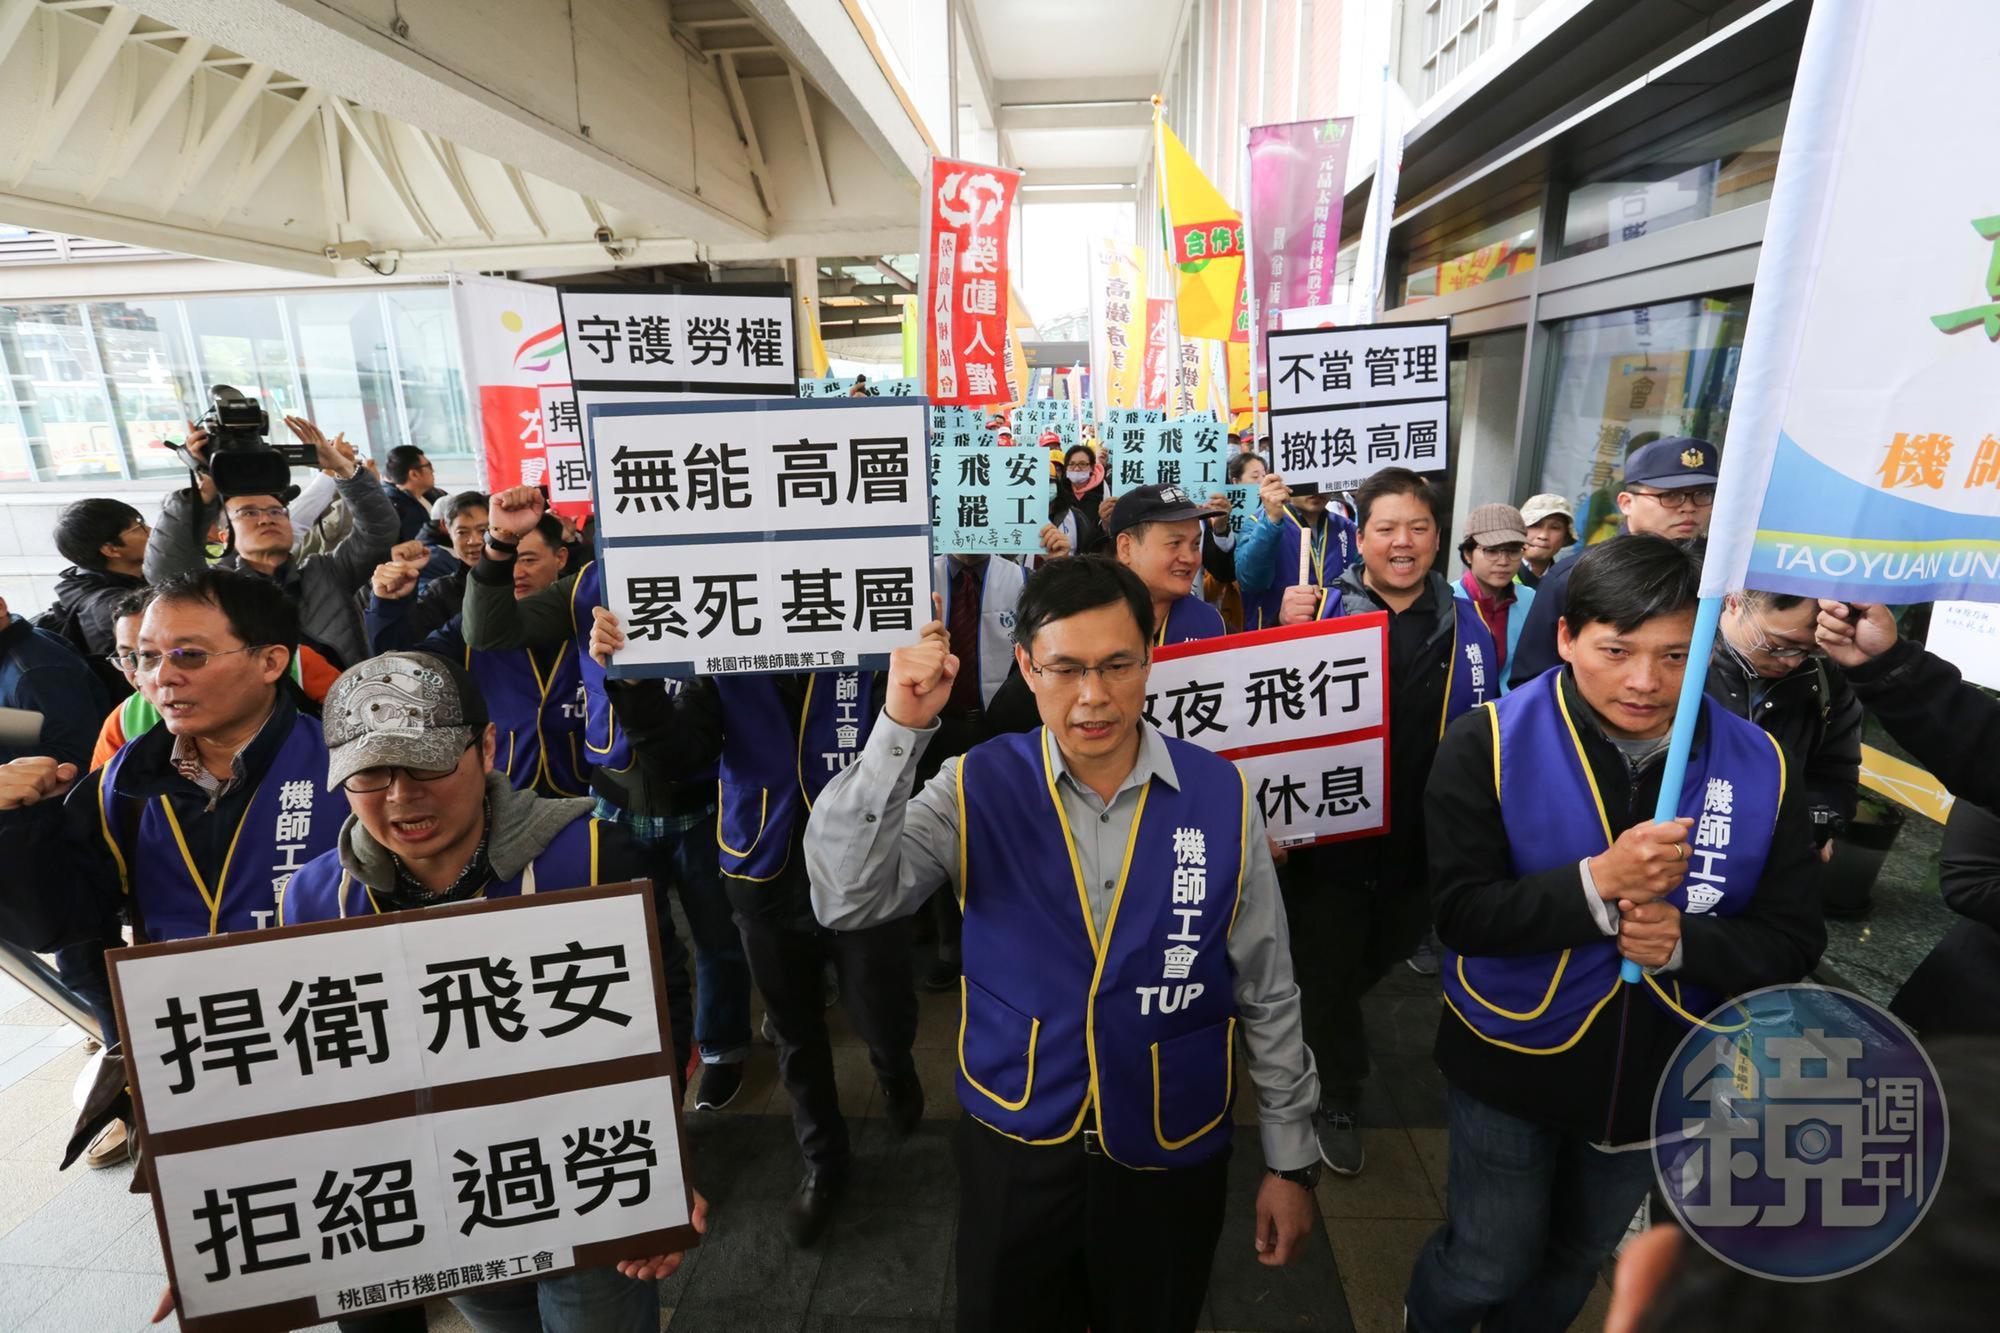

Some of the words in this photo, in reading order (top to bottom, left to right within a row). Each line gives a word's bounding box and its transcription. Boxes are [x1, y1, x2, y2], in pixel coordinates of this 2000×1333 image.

[577, 315, 674, 365] 守護
[686, 316, 784, 367] 勞權
[1278, 349, 1353, 394] 不當
[1364, 344, 1439, 388] 管理
[1122, 428, 1220, 454] 要飛安
[1281, 427, 1357, 472] 撤換
[1366, 420, 1437, 464] 高層
[611, 443, 752, 514] 無能
[772, 437, 909, 507] 高層
[1120, 460, 1218, 486] 挺罷工
[1775, 543, 1943, 581] TAOYUAN
[627, 575, 761, 641] 累死
[781, 567, 914, 633] 基層
[706, 650, 845, 672] 桃園市機師職業工會
[1244, 656, 1369, 728] 飛行
[1256, 765, 1371, 829] 休息
[1685, 776, 1734, 914] 機師工會
[1162, 827, 1207, 980] 機師工會
[155, 972, 390, 1095] 捍衛
[419, 940, 633, 1055] 飛安
[1135, 982, 1205, 1016] TUP
[192, 1159, 425, 1283] 拒絕
[452, 1118, 659, 1238] 過勞
[337, 1249, 555, 1312] 桃園市機師職業工會
